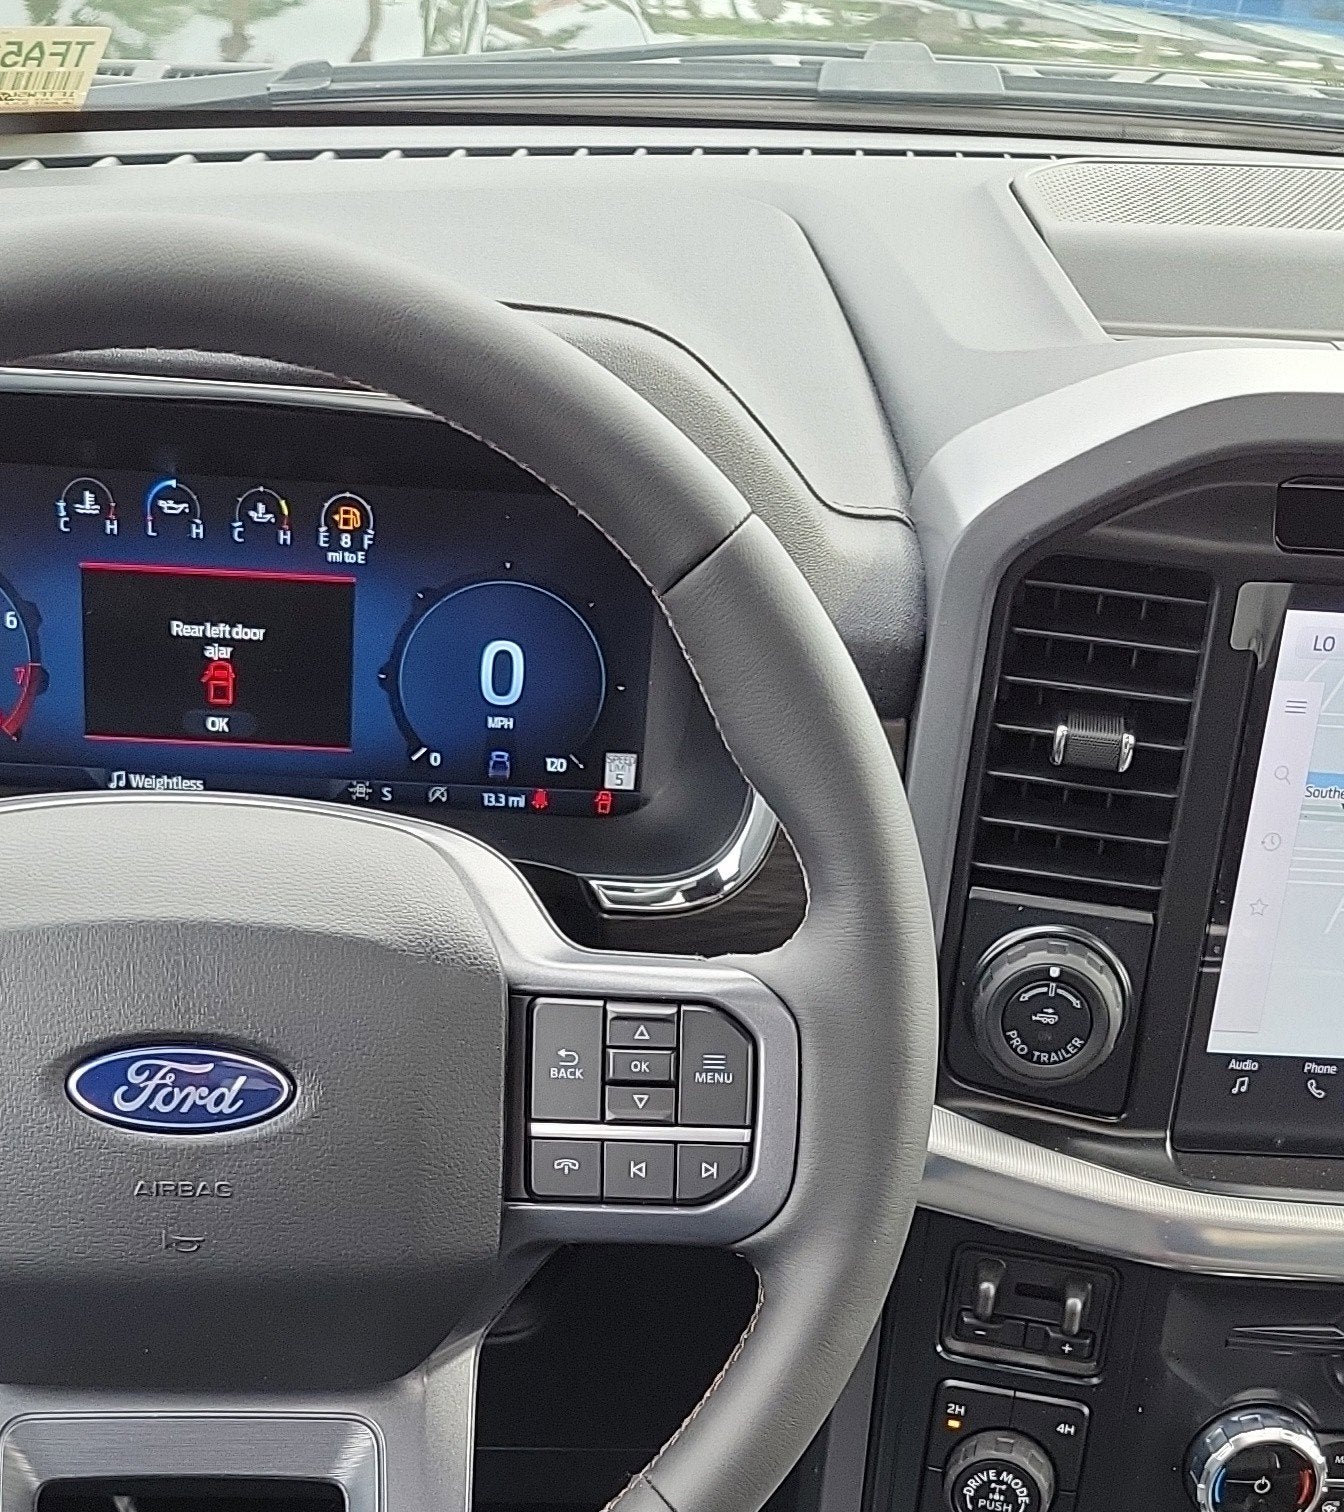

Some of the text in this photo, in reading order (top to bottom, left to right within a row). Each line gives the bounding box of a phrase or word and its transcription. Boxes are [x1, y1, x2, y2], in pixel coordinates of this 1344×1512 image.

[105, 519, 118, 535] H
[191, 523, 204, 539] H
[279, 530, 291, 545] H
[6, 611, 18, 629] 6
[170, 620, 266, 641] Rear left door
[204, 643, 233, 660] ajar
[1312, 635, 1336, 653] LO
[480, 639, 525, 706] 0
[207, 716, 229, 732] OK
[486, 715, 514, 730] MPH
[429, 751, 441, 766] 0
[545, 757, 567, 772] 120
[128, 773, 204, 791] Weightless
[614, 773, 624, 786] 5
[381, 787, 392, 800] S
[482, 792, 525, 808] 13.3 mi
[1006, 1029, 1085, 1063] PRO TRAILER
[630, 1061, 649, 1072] OK
[1228, 1059, 1258, 1071] Audio
[1304, 1062, 1337, 1075] Phone
[550, 1068, 583, 1079] BACK
[695, 1072, 733, 1084] MENU
[113, 1059, 247, 1115] Ford
[133, 1180, 233, 1198] AIRBAG
[946, 1403, 965, 1416] 2H
[1056, 1424, 1075, 1435] 4H
[963, 1469, 1029, 1505] DRIVE MODE
[978, 1498, 1012, 1512] PUSH
